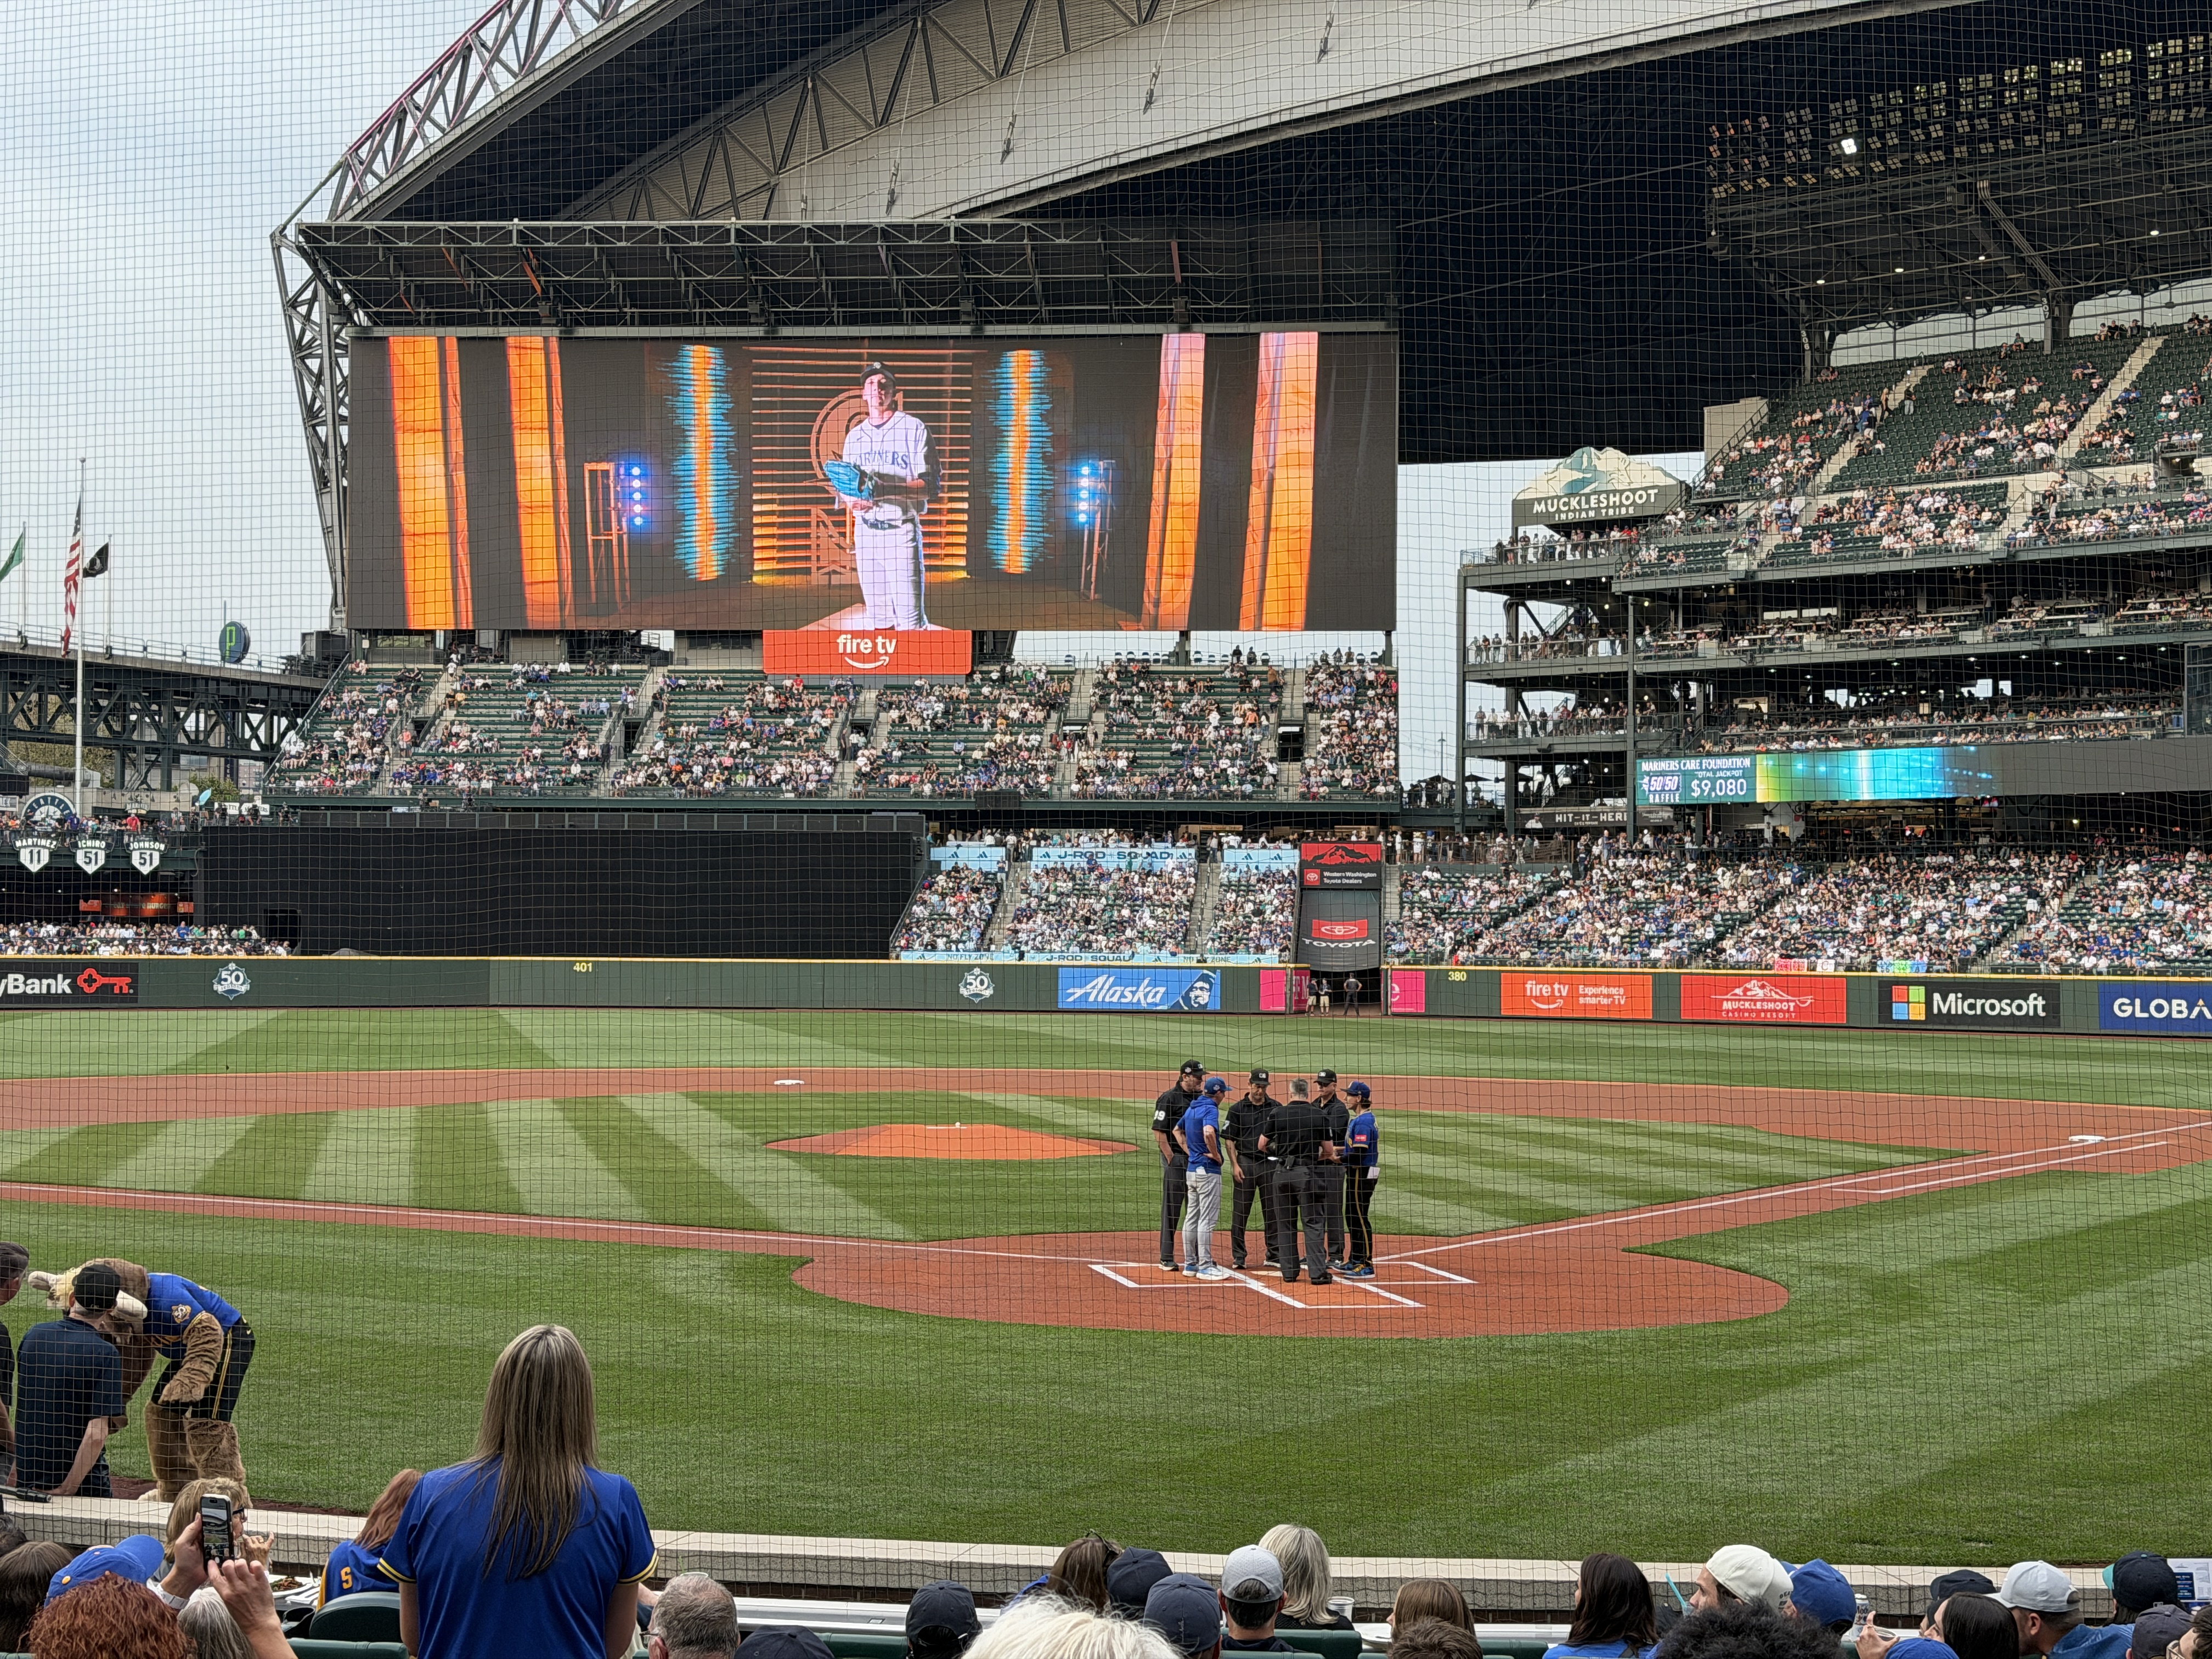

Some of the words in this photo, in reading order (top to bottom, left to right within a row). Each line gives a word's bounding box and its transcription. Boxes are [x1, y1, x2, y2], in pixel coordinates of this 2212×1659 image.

[1533, 489, 1658, 514] MUCKLESHOOT
[1555, 510, 1595, 521] INDIAN
[1601, 507, 1634, 516] TRIBE
[837, 634, 872, 654] fire
[876, 636, 897, 654] tv
[1641, 760, 1679, 772] MARINERS
[1680, 759, 1700, 770] CARE
[1702, 758, 1751, 770] FOUNDATION
[1649, 776, 1678, 791] 50/50
[1691, 779, 1747, 798] $9,080
[1649, 793, 1680, 803] RAFFLE
[27, 797, 70, 818] SEATTLE
[15, 838, 57, 849] MARTINEZ
[78, 840, 105, 849] ICHIRO
[129, 841, 165, 850] JOHNSON
[29, 850, 41, 865] 11
[83, 851, 98, 866] 51
[138, 852, 154, 867] 51
[1058, 850, 1105, 859] J-ROD
[1302, 938, 1376, 948] TOYOTA
[573, 962, 592, 972] 401
[221, 970, 244, 985] 50
[966, 975, 988, 989] 50
[1448, 971, 1466, 981] 380
[1066, 974, 1167, 1006] Alaska
[1525, 980, 1551, 996] fire
[1553, 982, 1568, 996] tv
[1578, 985, 1624, 995] Experience
[1578, 996, 1612, 1005] smarter
[1613, 996, 1626, 1005] TV
[1722, 1001, 1796, 1011] MUCKLESHOOT
[1933, 992, 2046, 1017] Microsoft
